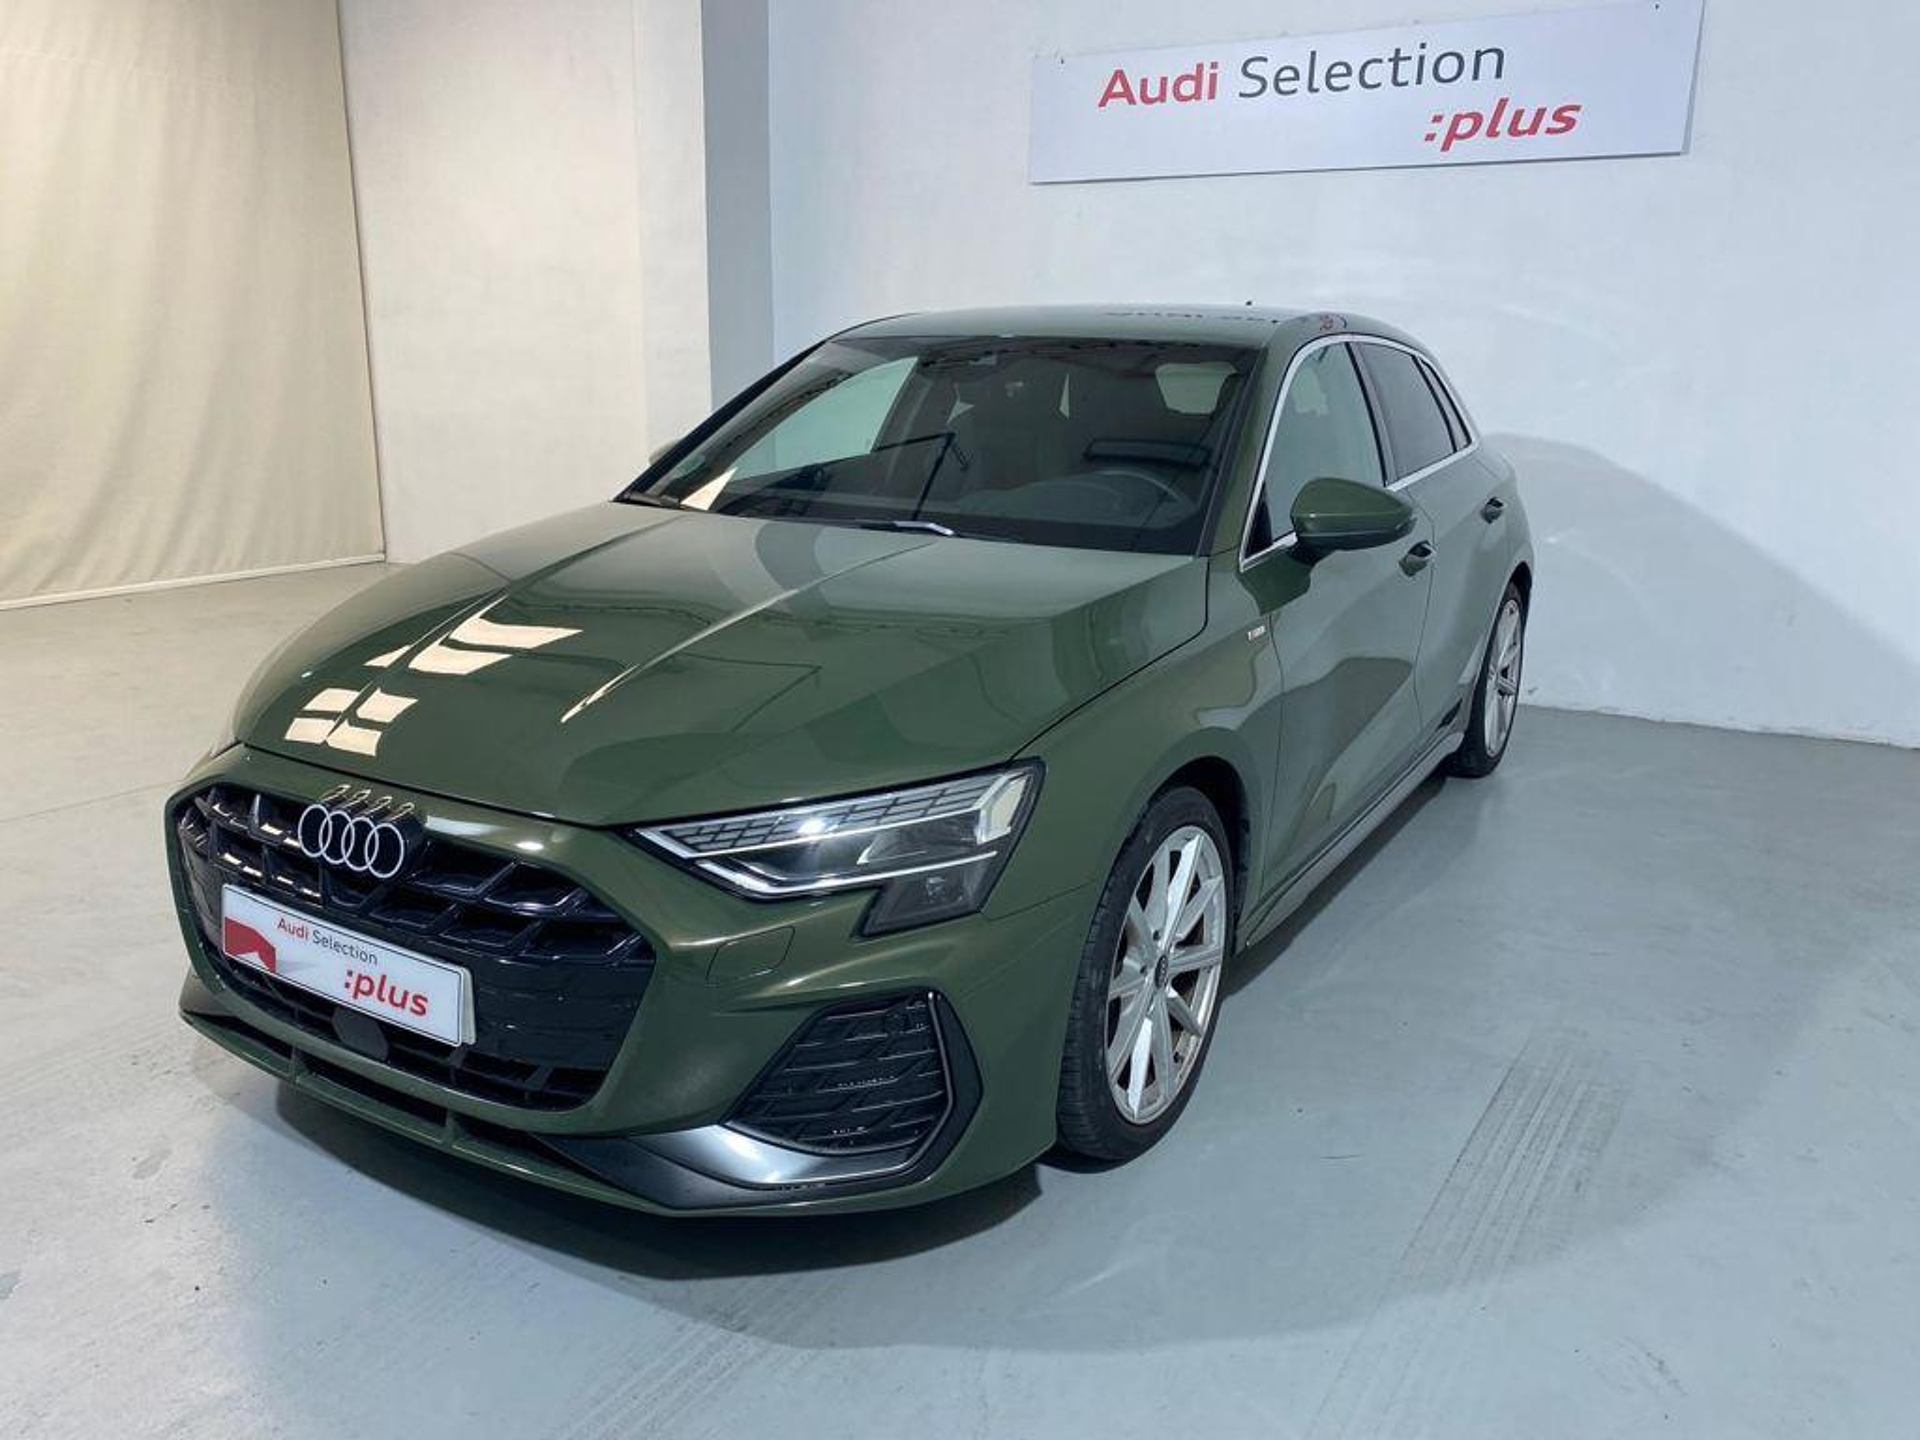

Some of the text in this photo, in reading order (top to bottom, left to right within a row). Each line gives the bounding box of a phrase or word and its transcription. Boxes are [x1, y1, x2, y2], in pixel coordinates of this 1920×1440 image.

[1098, 42, 1506, 108] Audi Selection
[1424, 97, 1581, 152] :plus
[277, 918, 378, 966] Audi Selection
[344, 969, 429, 1017] :plus
